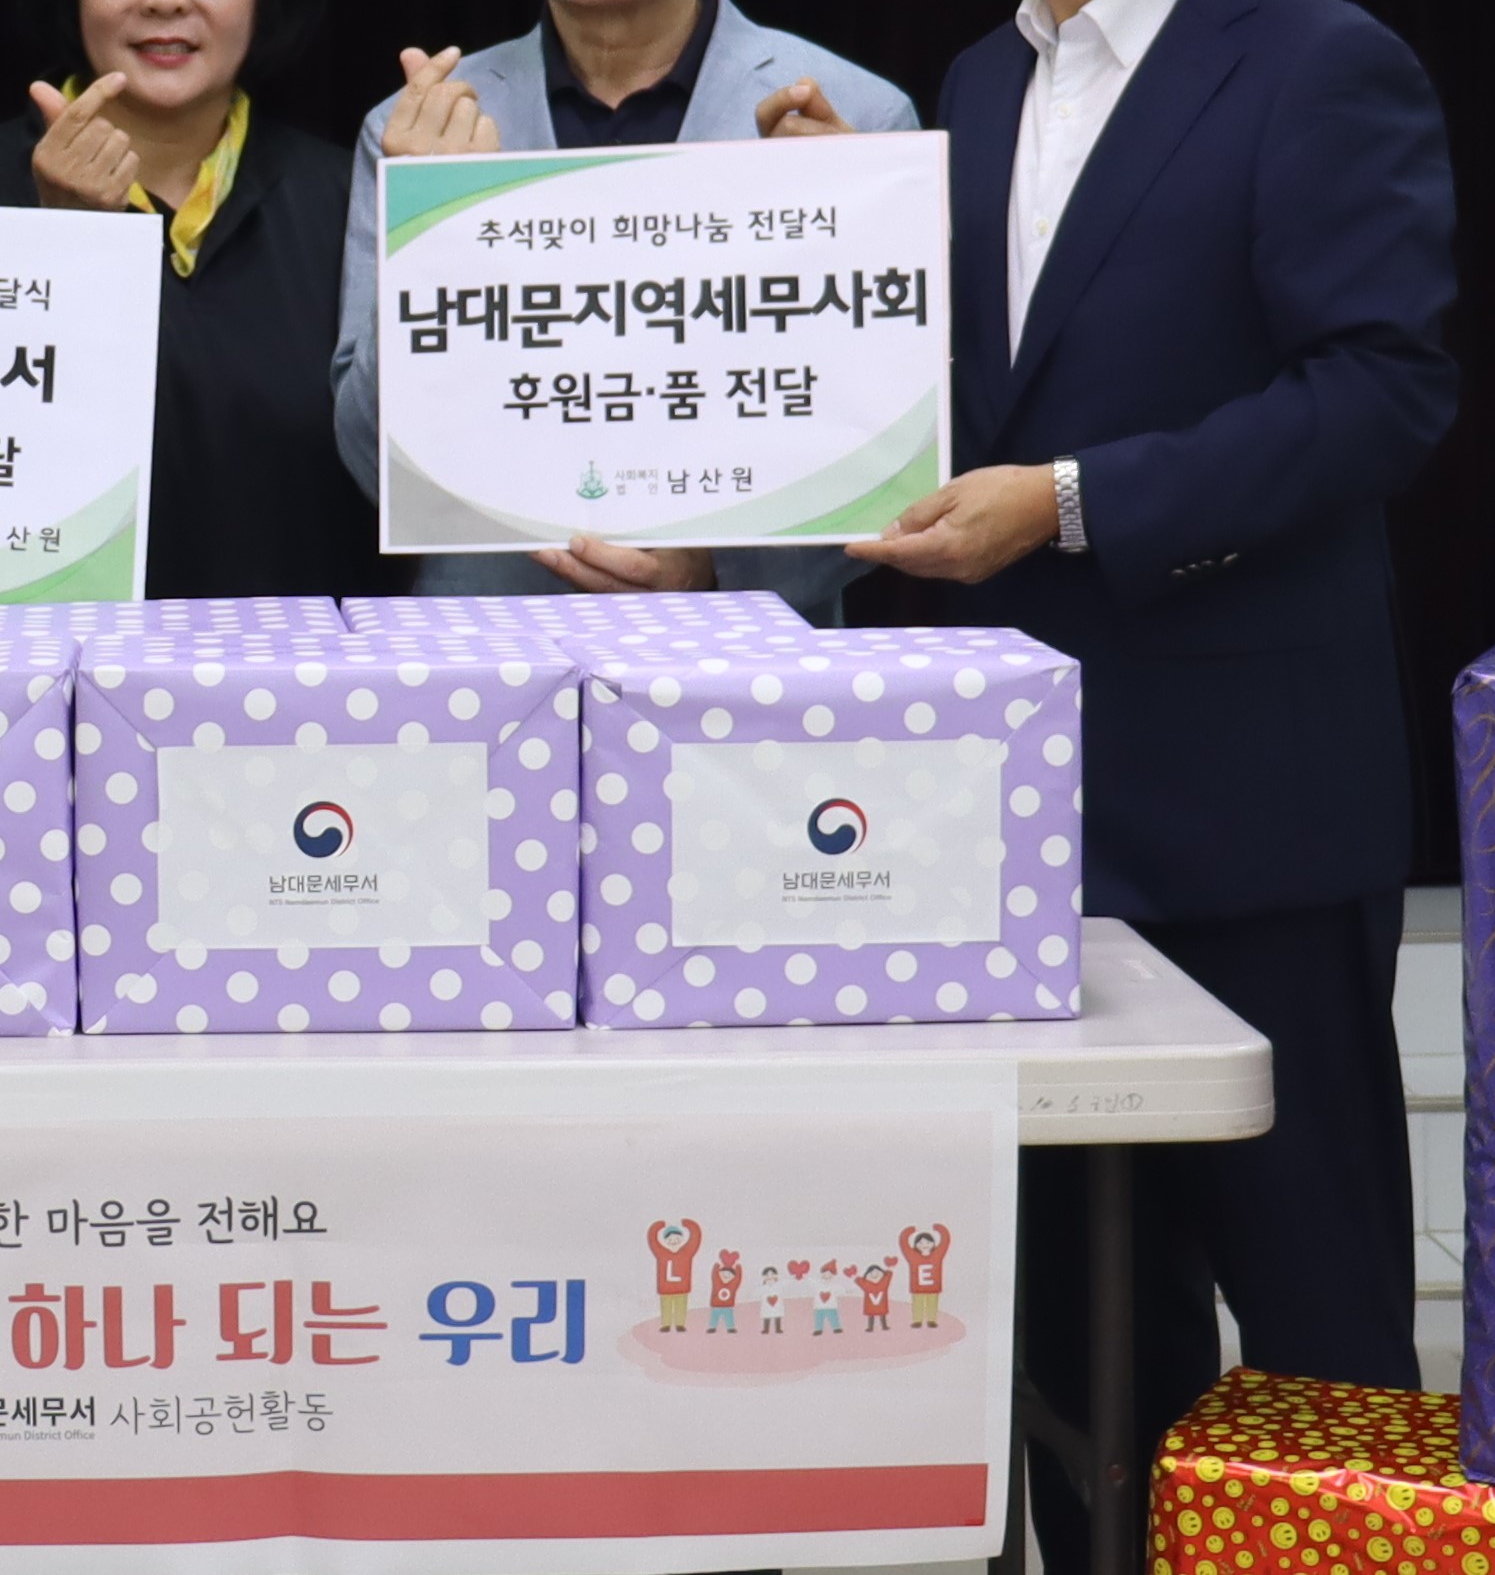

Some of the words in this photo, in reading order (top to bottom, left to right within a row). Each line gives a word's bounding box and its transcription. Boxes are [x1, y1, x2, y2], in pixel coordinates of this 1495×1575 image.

[477, 218, 594, 250] 추석맞이
[613, 213, 732, 246] 희망나눔
[749, 207, 835, 240] 전달식
[400, 268, 927, 353] 남대문지역세무사회
[727, 366, 817, 417] 전달
[270, 874, 377, 893] 남대문세무서
[783, 871, 890, 890] 남대문세무서
[47, 1199, 180, 1247] 마음을
[198, 1196, 327, 1244] 전해요
[8, 1283, 186, 1370] 하나
[216, 1280, 388, 1365] 되는
[419, 1279, 585, 1366] 우리
[24, 1430, 62, 1441] District
[64, 1429, 95, 1440] Office
[110, 1391, 333, 1435] 사회공헌활동
